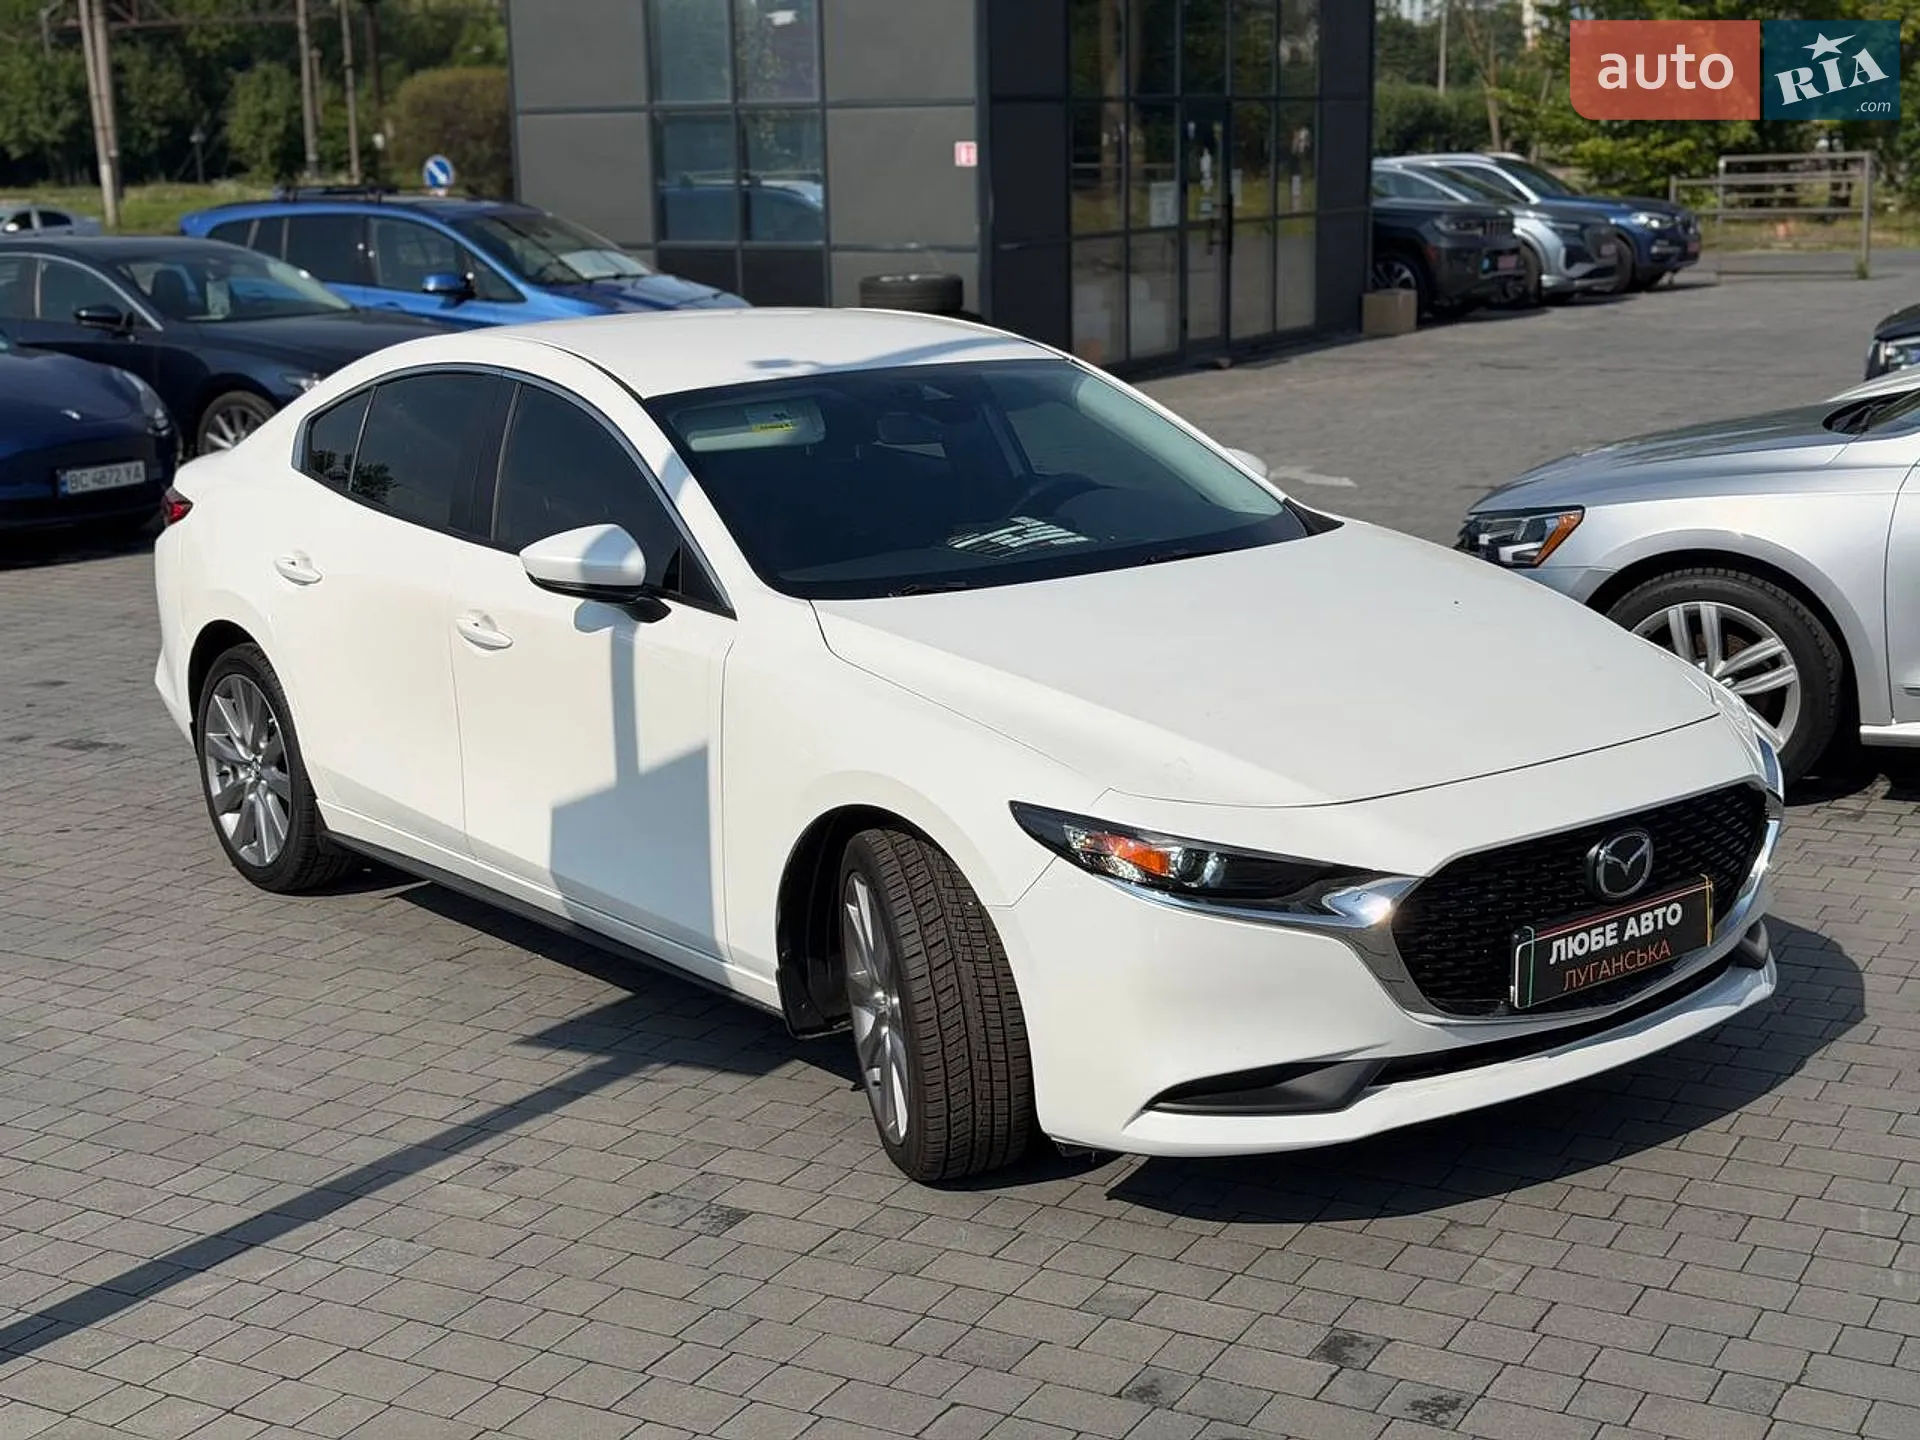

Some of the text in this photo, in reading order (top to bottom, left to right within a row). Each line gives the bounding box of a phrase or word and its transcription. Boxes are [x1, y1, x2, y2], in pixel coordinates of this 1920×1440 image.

[1549, 902, 1683, 965] ЛЮБЕ АВТО
[1562, 938, 1672, 992] ЛУГАНСЬКА
